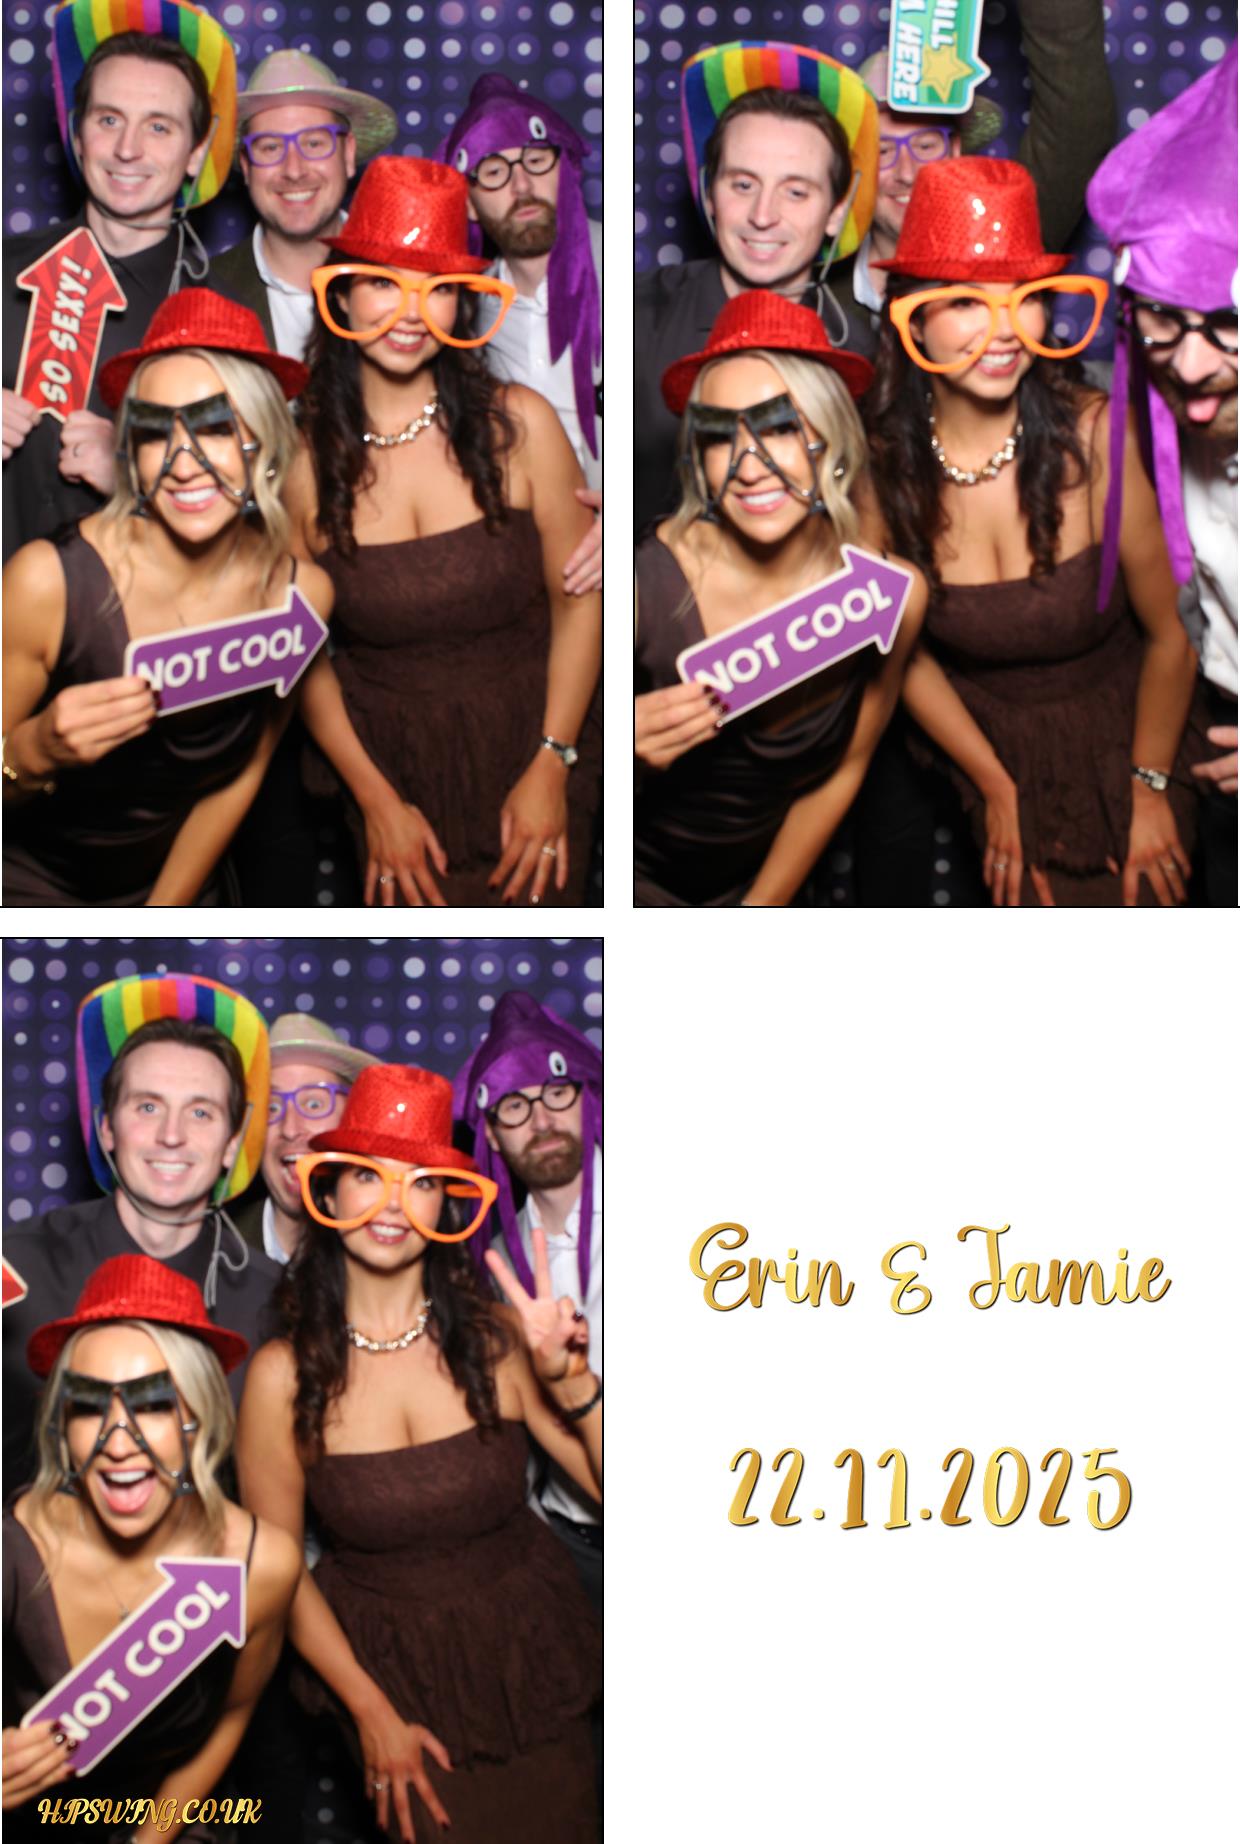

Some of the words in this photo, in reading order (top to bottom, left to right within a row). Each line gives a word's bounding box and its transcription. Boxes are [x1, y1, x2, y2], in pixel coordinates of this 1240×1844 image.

[893, 20, 923, 105] HERE
[48, 256, 93, 352] SEXY!
[39, 359, 72, 404] SO
[218, 624, 306, 675] COOL
[786, 579, 893, 653] COOL
[124, 1580, 231, 1678] COOL
